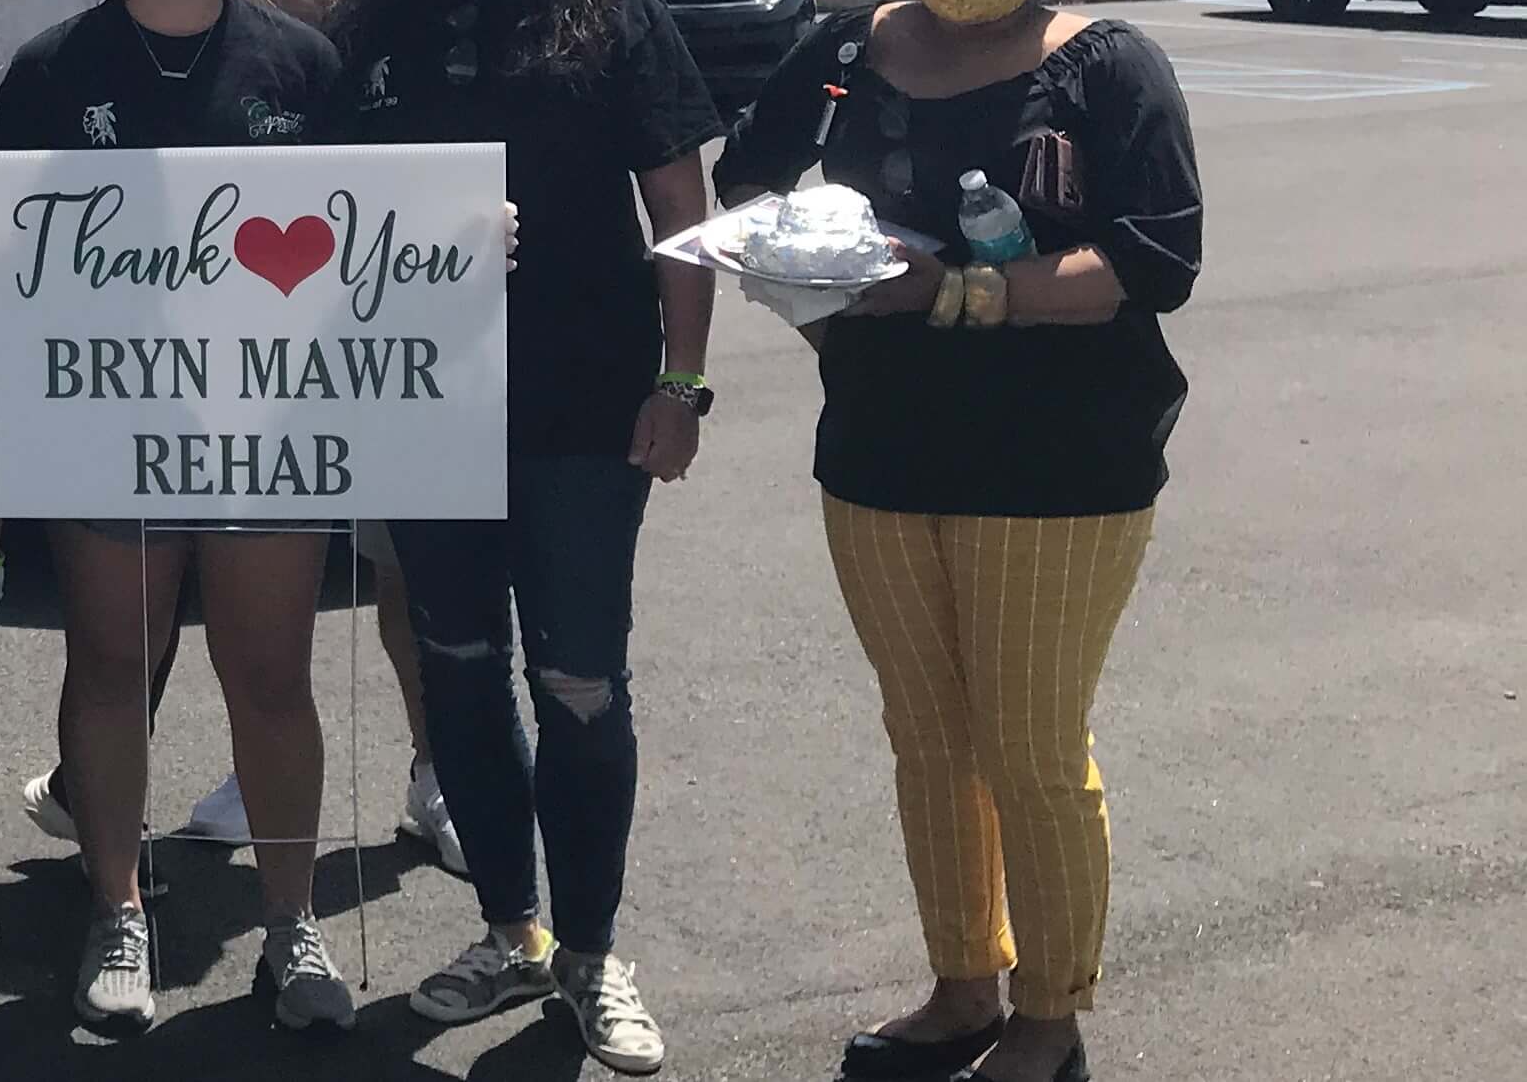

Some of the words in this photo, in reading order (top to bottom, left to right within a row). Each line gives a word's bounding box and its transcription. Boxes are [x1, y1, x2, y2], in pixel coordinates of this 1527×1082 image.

[13, 183, 240, 299] Thank
[328, 190, 473, 322] You
[44, 338, 210, 399] BRYN
[239, 337, 444, 399] MAWR
[133, 434, 352, 495] REHAB
